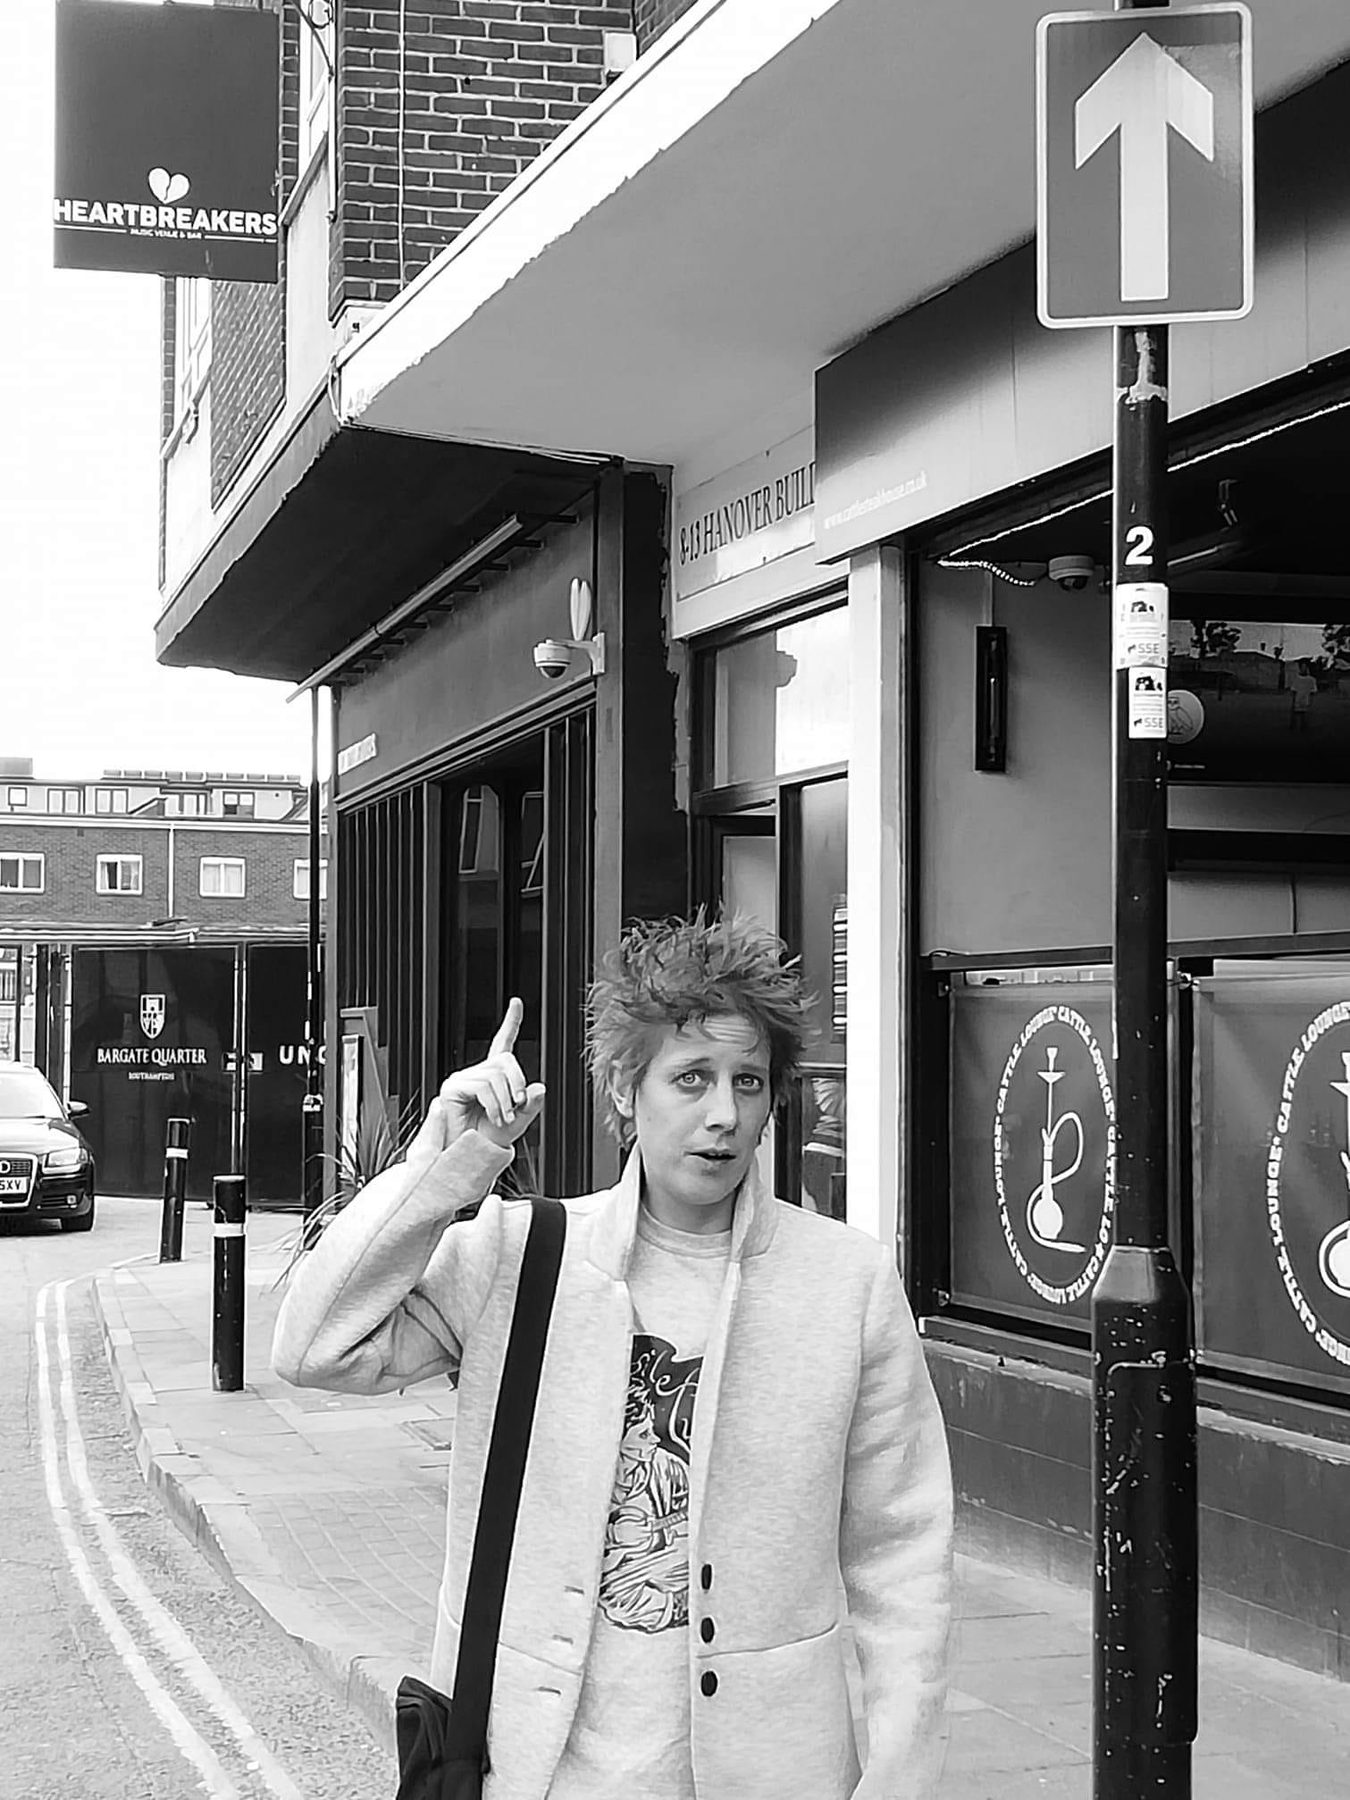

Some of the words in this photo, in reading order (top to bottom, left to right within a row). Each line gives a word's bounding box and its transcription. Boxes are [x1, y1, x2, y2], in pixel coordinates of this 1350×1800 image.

[54, 198, 277, 236] HEARTBREAKERS
[703, 485, 773, 556] HANOVER
[1125, 525, 1154, 566] 2
[1138, 642, 1160, 655] SSE
[1144, 717, 1164, 729] SSE
[97, 1048, 149, 1064] BARGATE
[151, 1048, 207, 1067] QUARTER
